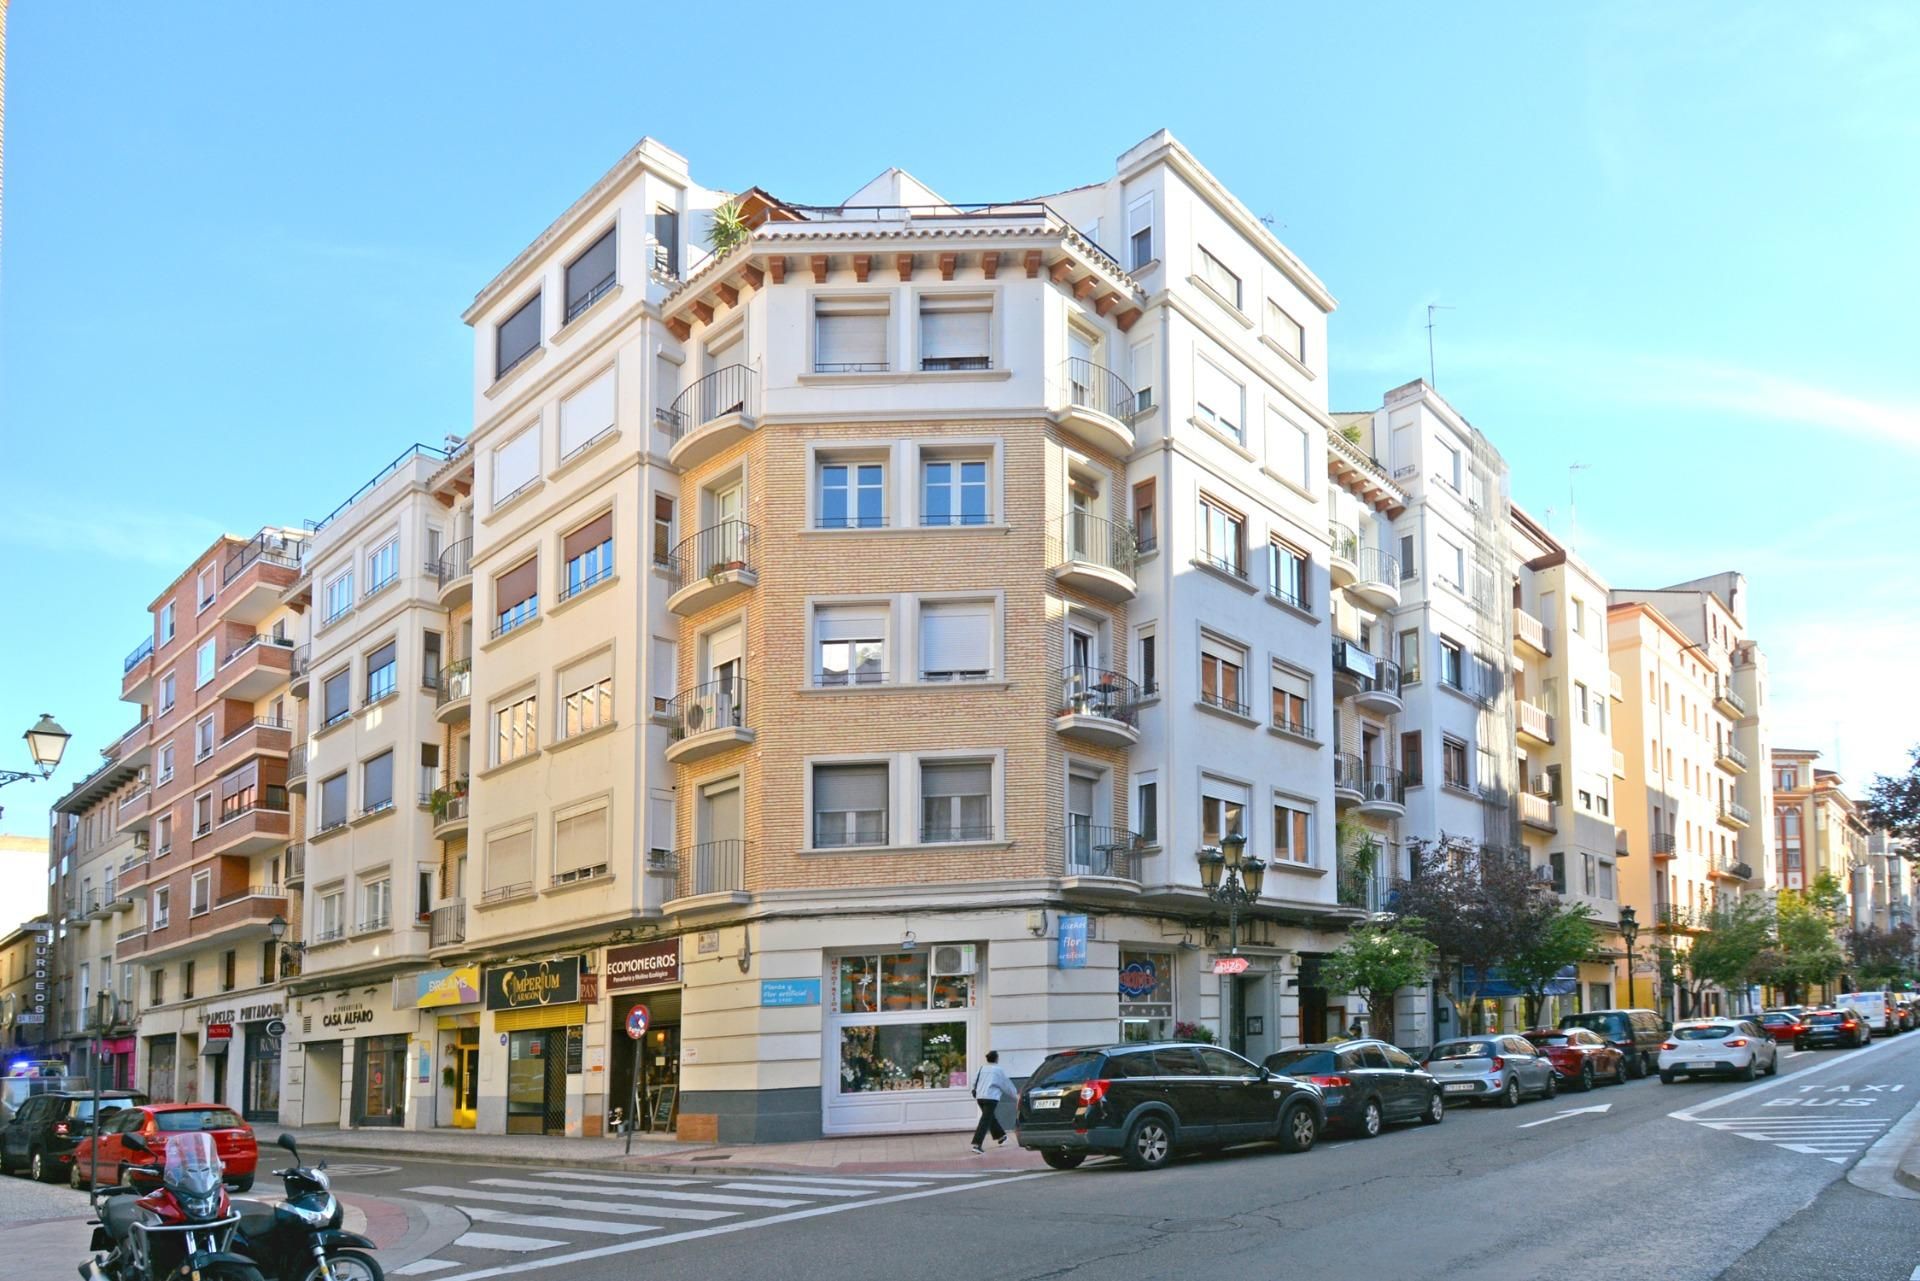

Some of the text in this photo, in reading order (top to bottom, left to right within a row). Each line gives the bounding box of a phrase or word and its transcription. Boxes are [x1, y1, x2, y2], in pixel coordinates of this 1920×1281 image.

[607, 953, 676, 975] ECOMONEGROS
[35, 935, 47, 1014] BURDEOS
[580, 984, 597, 998] PAN
[206, 1004, 281, 1024] PAPELES PINTADO
[323, 1009, 373, 1027] CASA ALFARO
[1800, 1084, 1905, 1092] TAXI
[1761, 1098, 1878, 1107] BUS
